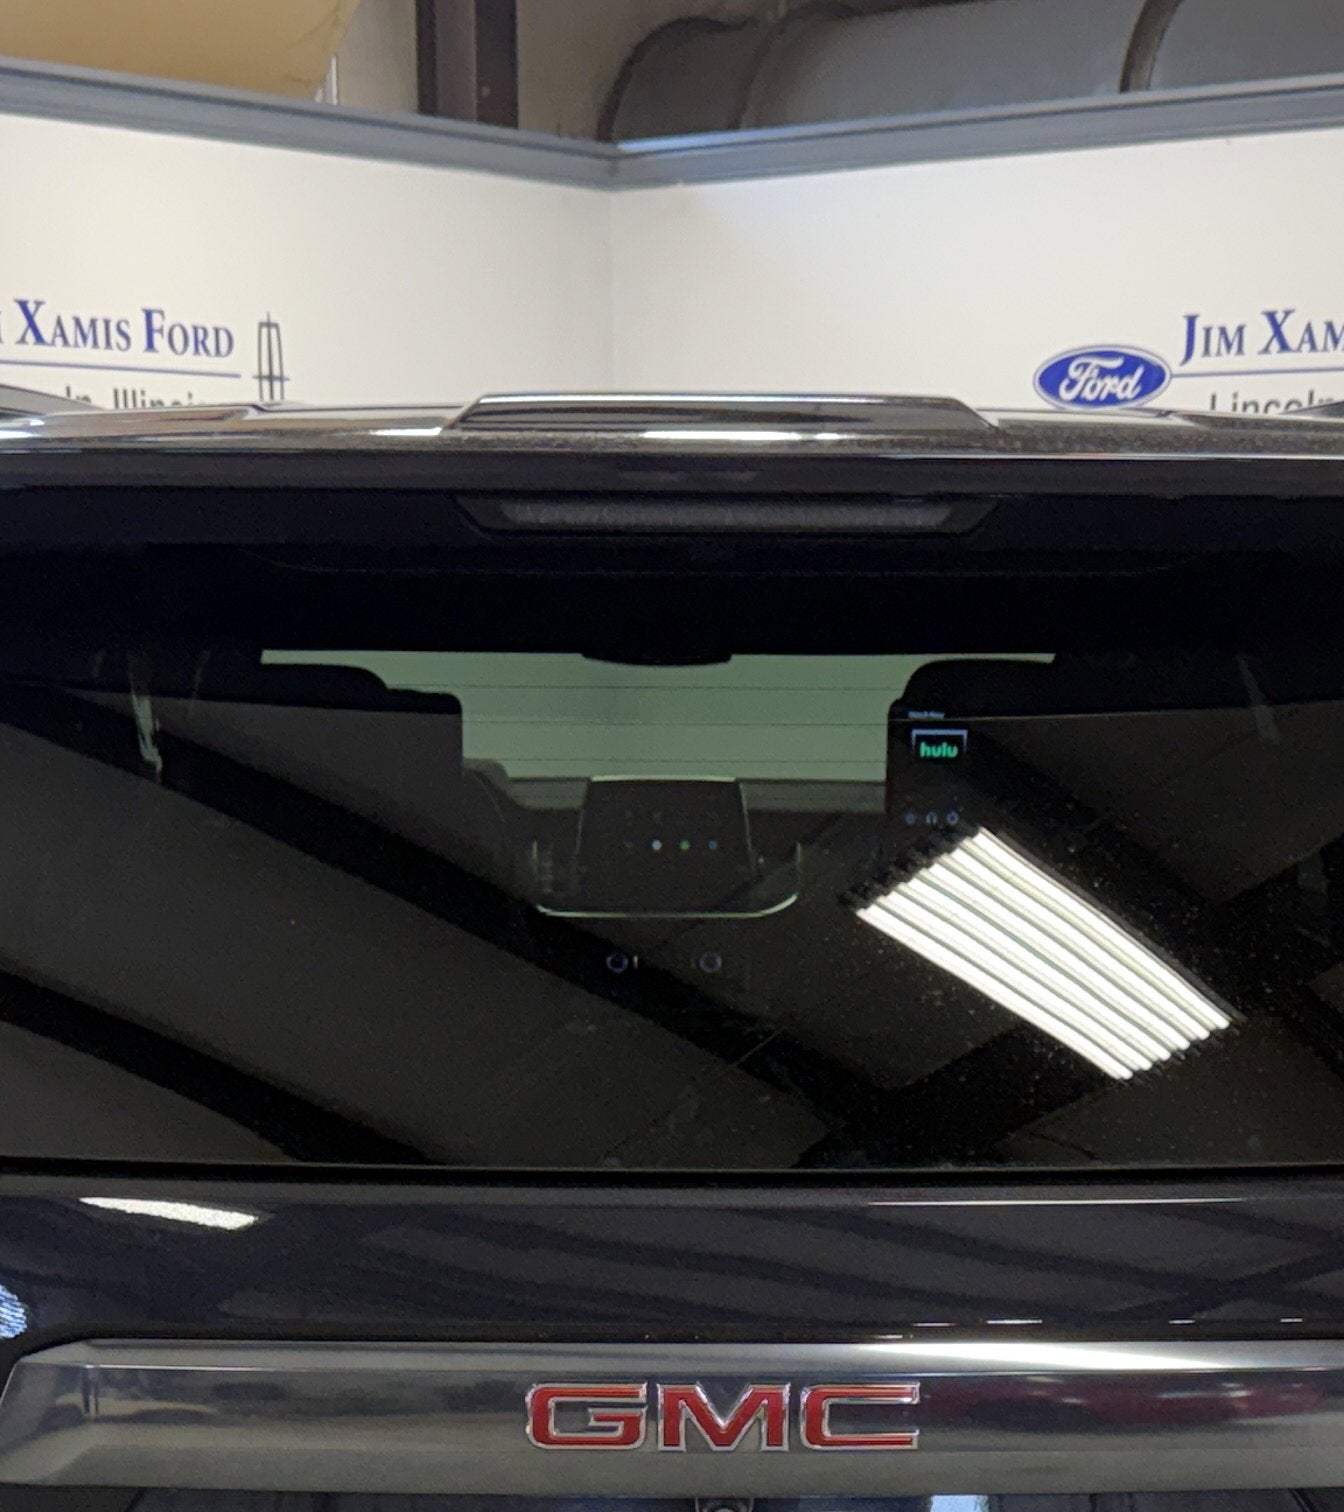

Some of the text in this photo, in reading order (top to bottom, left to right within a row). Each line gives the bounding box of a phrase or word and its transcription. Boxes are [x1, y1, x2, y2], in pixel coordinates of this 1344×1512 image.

[14, 299, 133, 353] XAMIS
[141, 308, 234, 359] FORD
[1180, 313, 1246, 366] JIM
[1059, 355, 1143, 401] Ford
[919, 741, 958, 758] hulu
[524, 1382, 921, 1452] GMC
